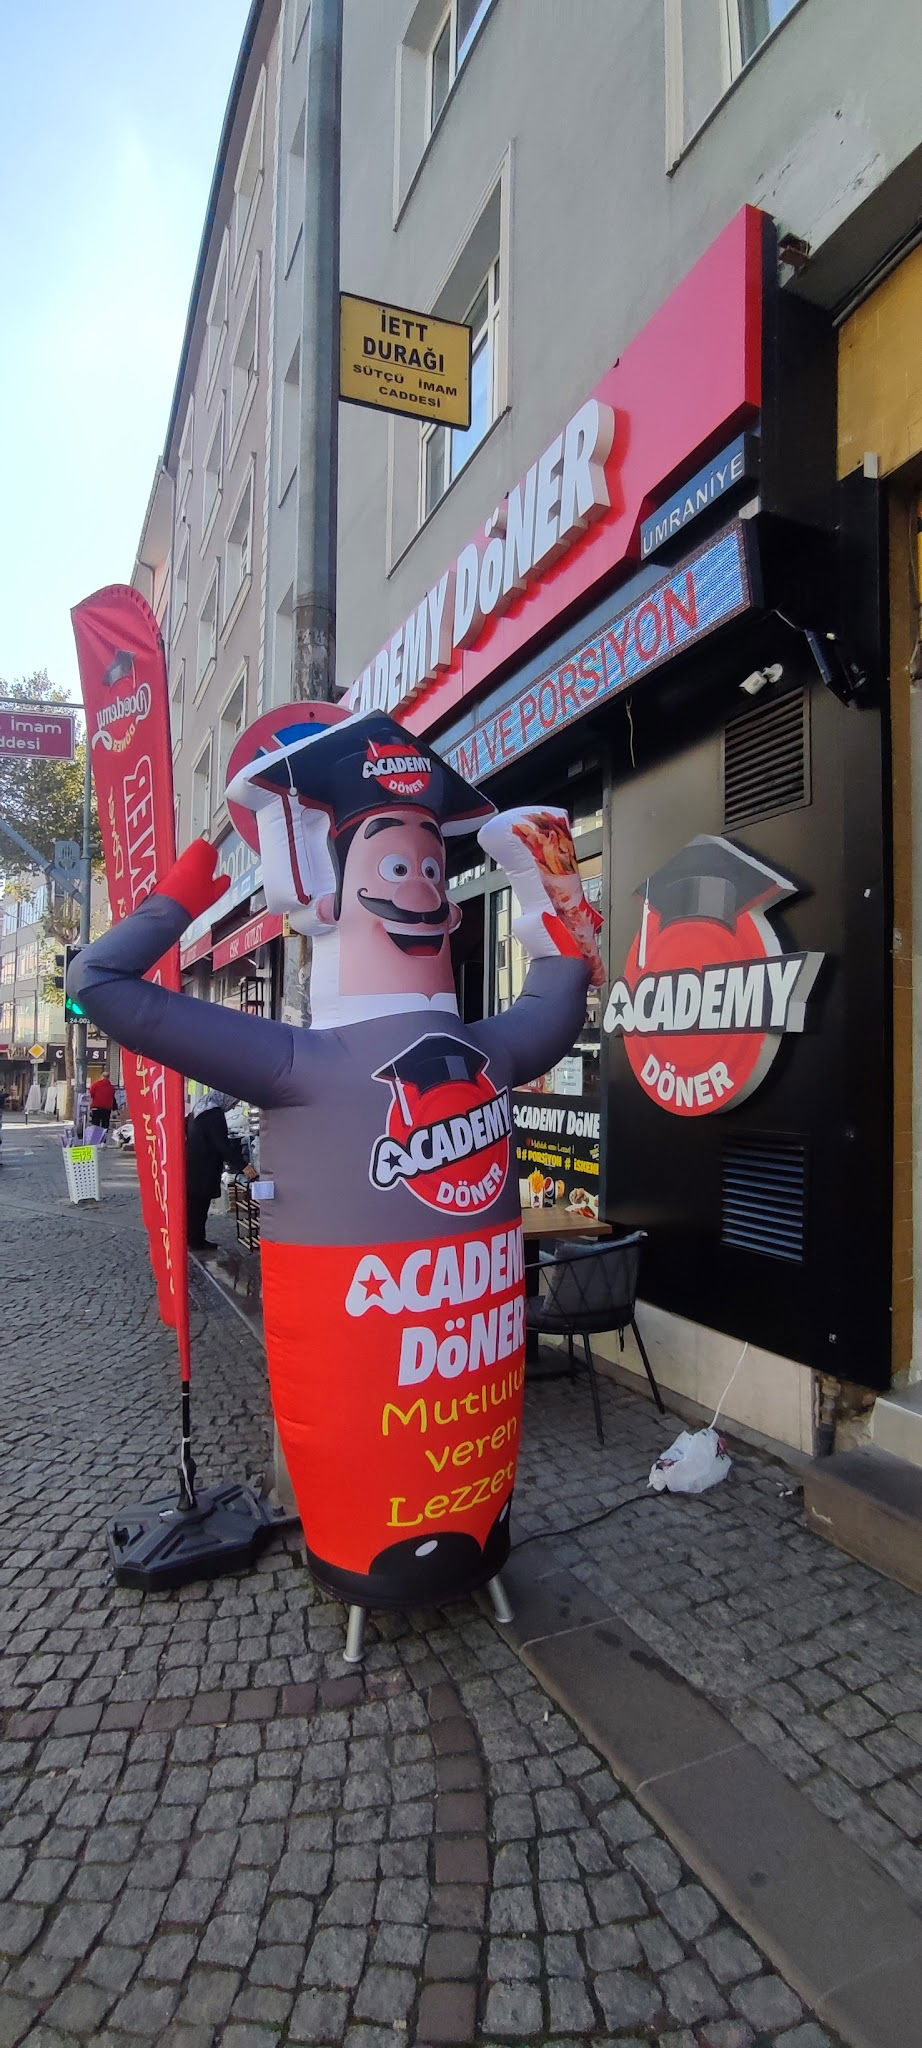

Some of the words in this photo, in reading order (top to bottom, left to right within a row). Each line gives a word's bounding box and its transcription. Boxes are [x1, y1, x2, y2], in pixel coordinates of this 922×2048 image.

[381, 309, 428, 342] İETT
[363, 336, 444, 373] DURAĞI
[353, 364, 404, 384] SÜTÇÜ
[418, 378, 457, 396] İMAM
[378, 386, 440, 408] CADDESİ
[349, 570, 451, 714] CADEMY
[11, 715, 62, 735] İmam
[362, 757, 432, 779] ACADEMY
[388, 779, 425, 794] DÖNER
[603, 960, 803, 1033] ACADEMY
[640, 1053, 735, 1108] DÖNER
[376, 1094, 511, 1184] ACADEMY
[436, 1162, 504, 1208] DÖNER
[345, 1227, 525, 1317] ACADEM
[381, 1364, 526, 1436] Mutlulu
[424, 1415, 518, 1473] veren
[386, 1460, 515, 1528] Lezzet
